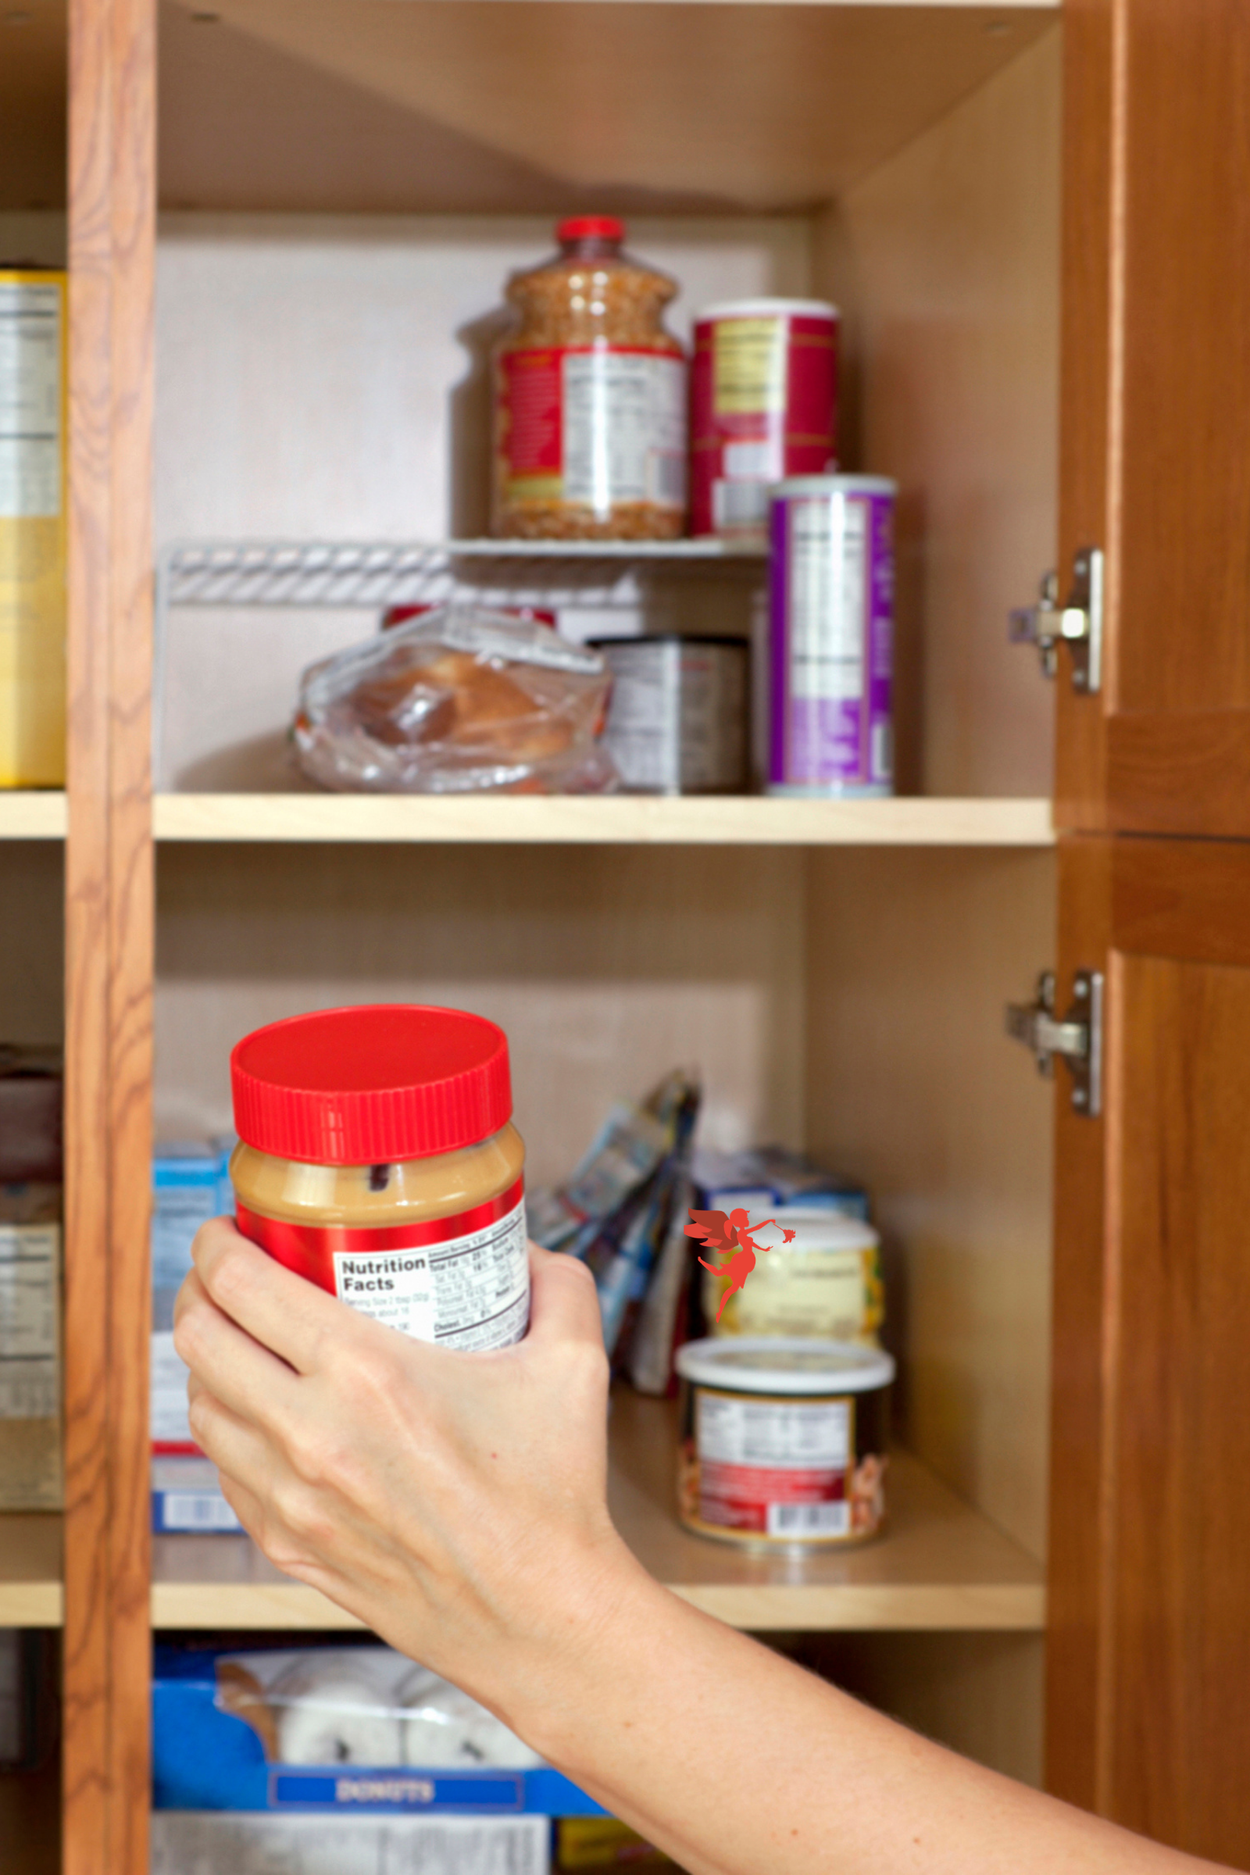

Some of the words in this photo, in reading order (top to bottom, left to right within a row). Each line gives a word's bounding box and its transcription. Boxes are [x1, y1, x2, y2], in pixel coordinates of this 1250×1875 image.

[342, 1257, 426, 1275] Nutrition
[343, 1277, 395, 1292] Facts
[335, 1779, 435, 1803] DONUTS
